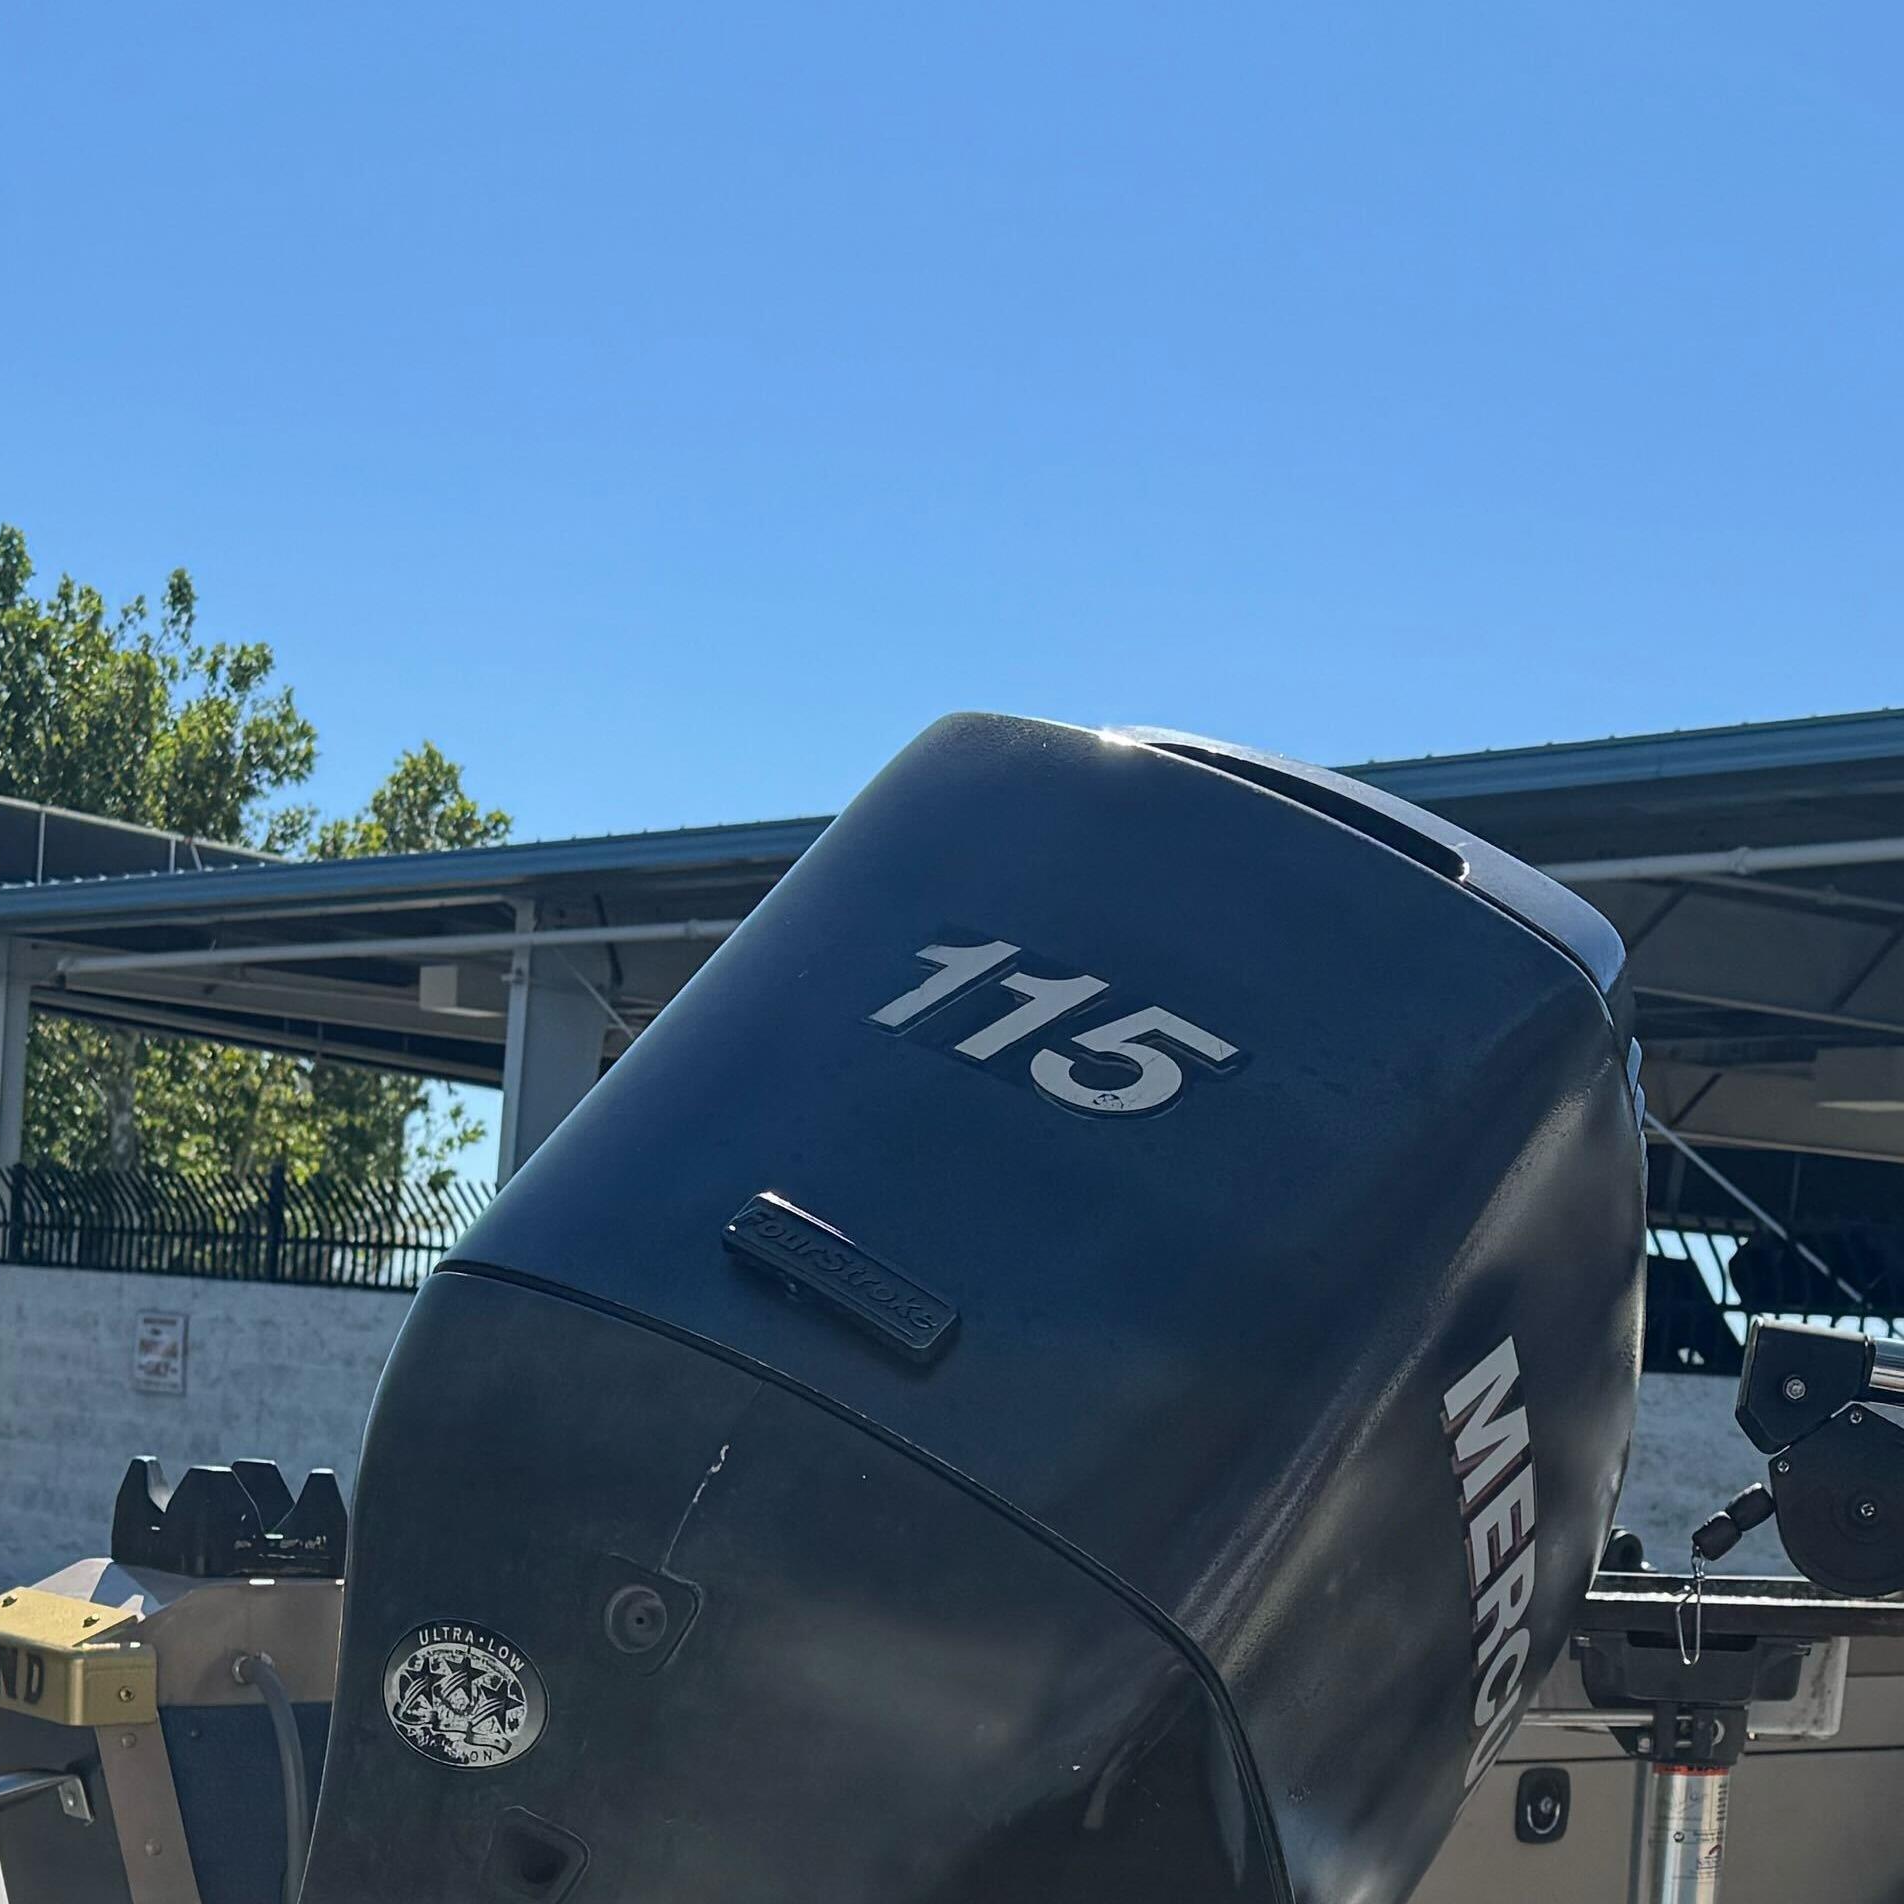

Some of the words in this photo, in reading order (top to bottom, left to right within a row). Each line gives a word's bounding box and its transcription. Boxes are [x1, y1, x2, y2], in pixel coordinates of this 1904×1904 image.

[856, 938, 1242, 1114] 115
[738, 1203, 939, 1331] FourStroke
[1440, 1335, 1537, 1818] MERCU
